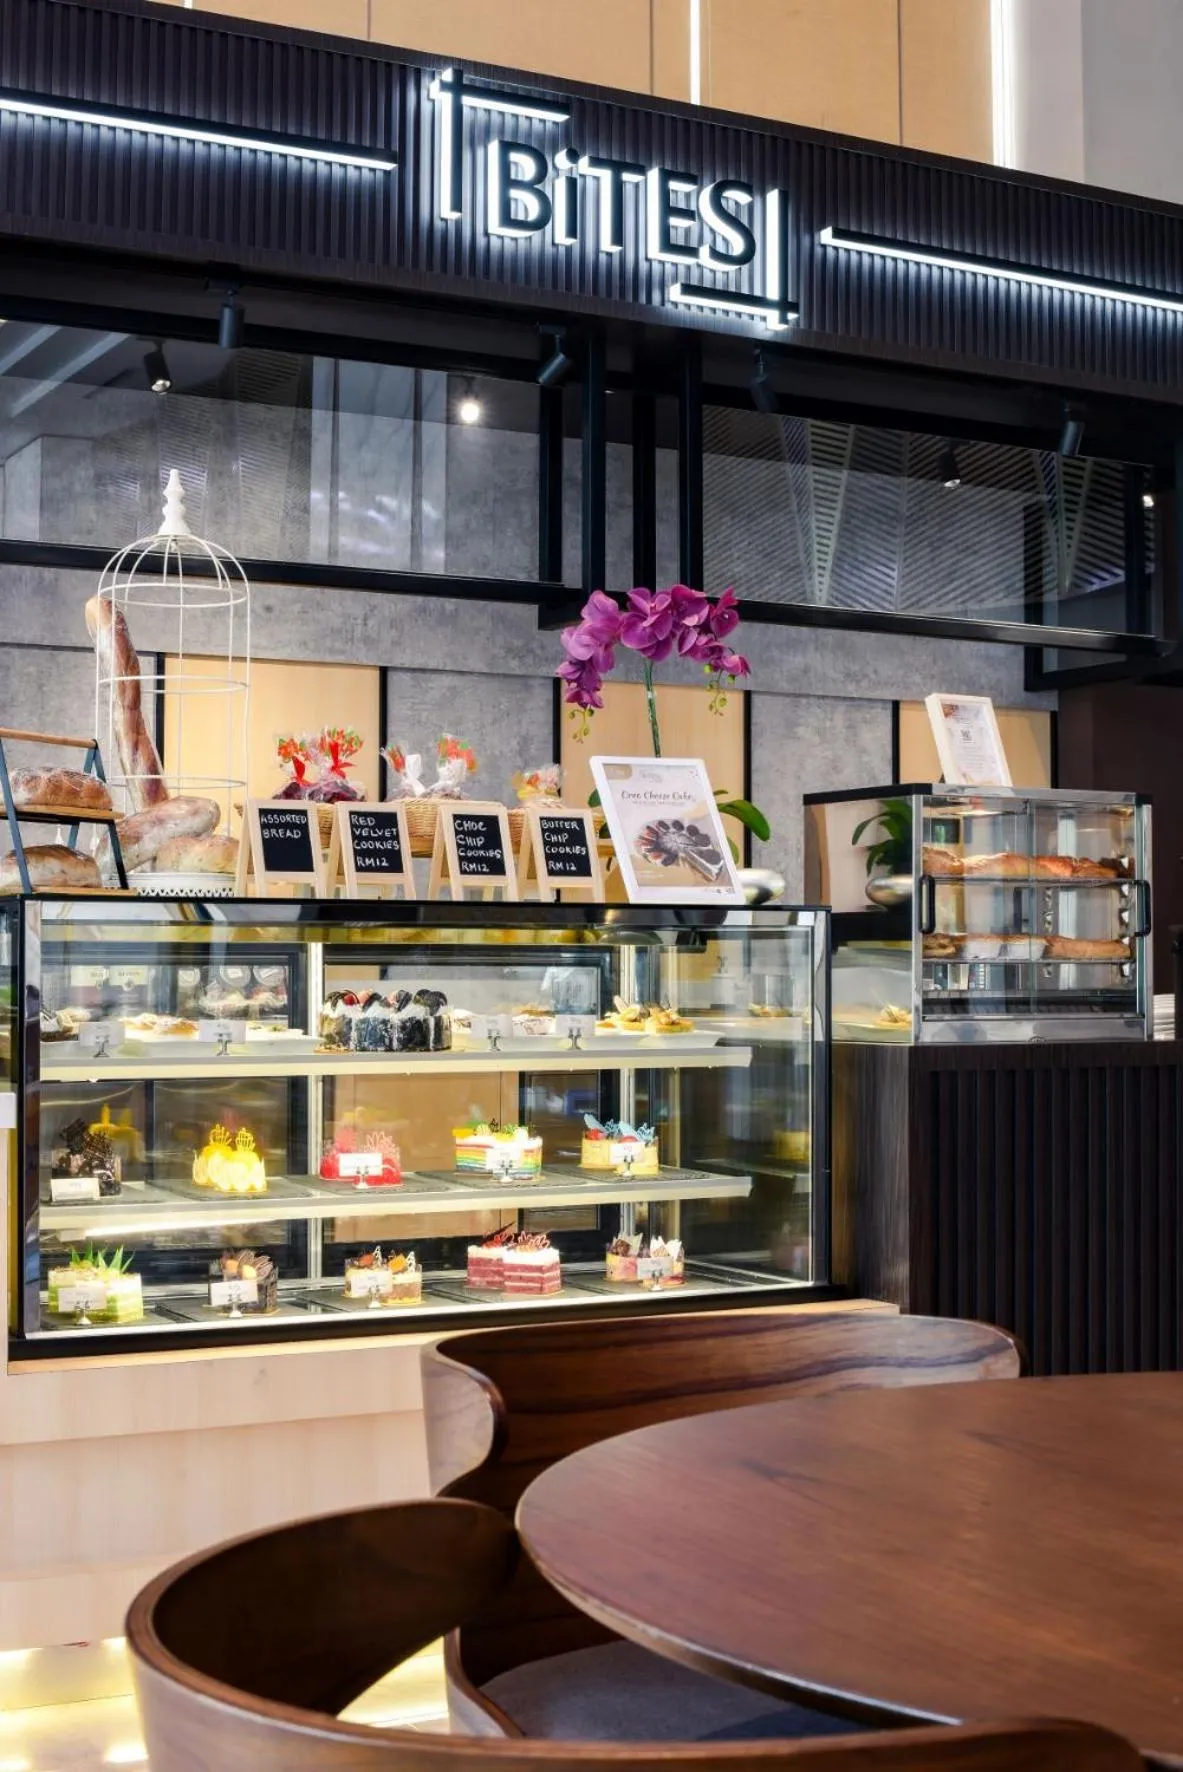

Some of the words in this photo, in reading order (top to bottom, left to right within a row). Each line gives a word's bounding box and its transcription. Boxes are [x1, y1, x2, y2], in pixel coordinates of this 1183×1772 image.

[260, 814, 307, 824] ASSORTED
[351, 814, 376, 826] RED
[263, 828, 301, 839] BREAD
[353, 828, 397, 837] VELVET
[544, 832, 569, 843] CHIP
[353, 839, 400, 850] COOKIES
[456, 834, 485, 847] CHIP
[356, 856, 390, 868] RM12
[461, 862, 490, 873] RM12
